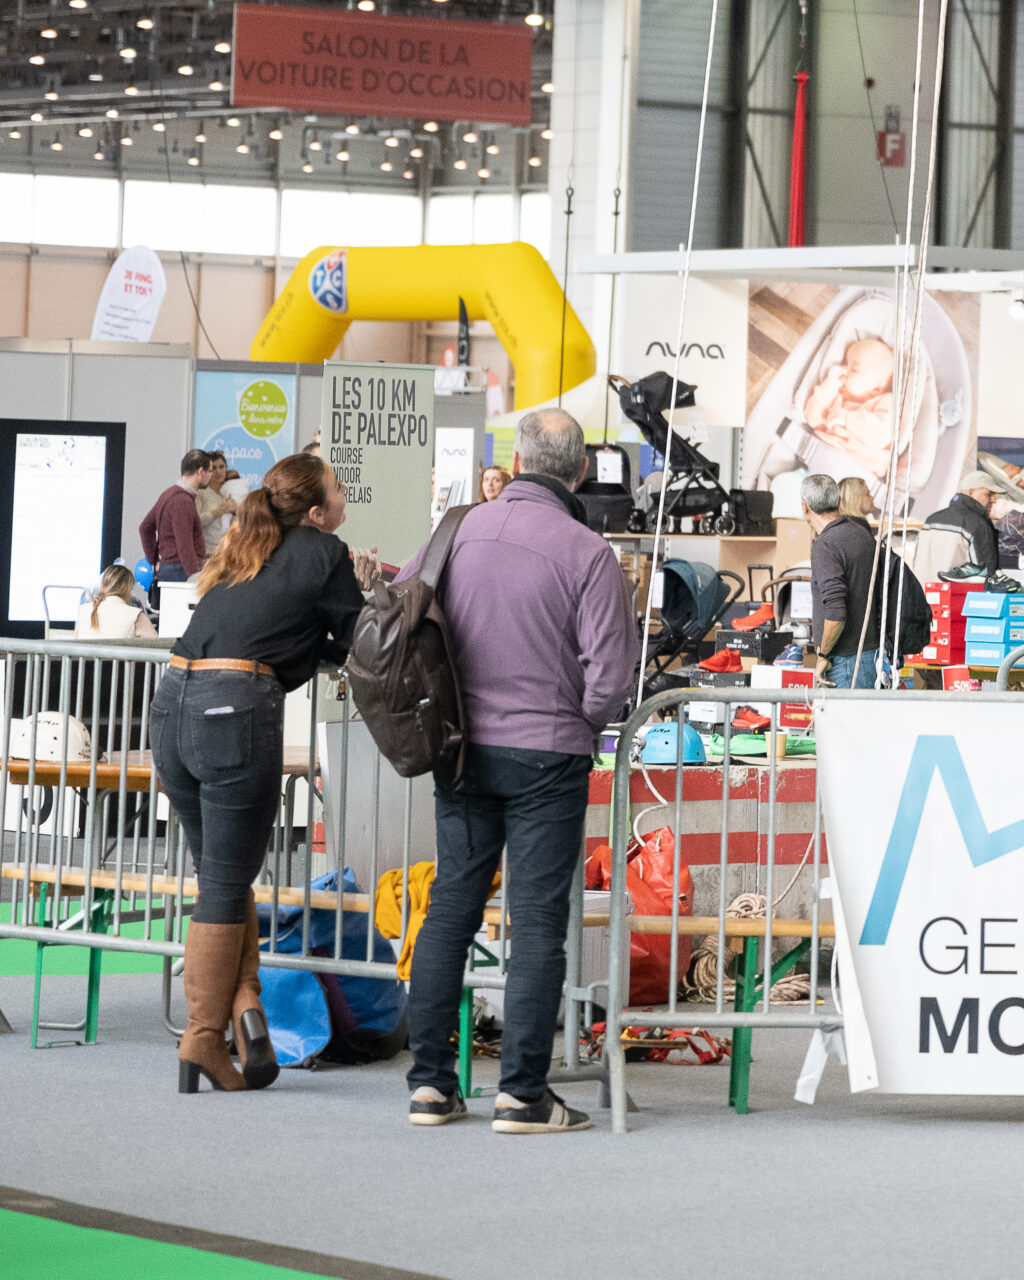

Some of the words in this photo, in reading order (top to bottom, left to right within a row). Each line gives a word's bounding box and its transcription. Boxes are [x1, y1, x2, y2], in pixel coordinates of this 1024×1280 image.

[302, 32, 389, 61] SALON
[398, 39, 434, 64] DE
[439, 43, 470, 67] LA
[238, 60, 351, 91] VOITURE
[362, 69, 527, 103] D'OCCASION
[886, 134, 901, 158] F
[332, 376, 362, 410] LES
[368, 377, 386, 411] 10
[391, 379, 416, 412] KM
[331, 411, 352, 445] DE
[357, 412, 428, 447] PALEXPO
[330, 447, 363, 464] COURSE
